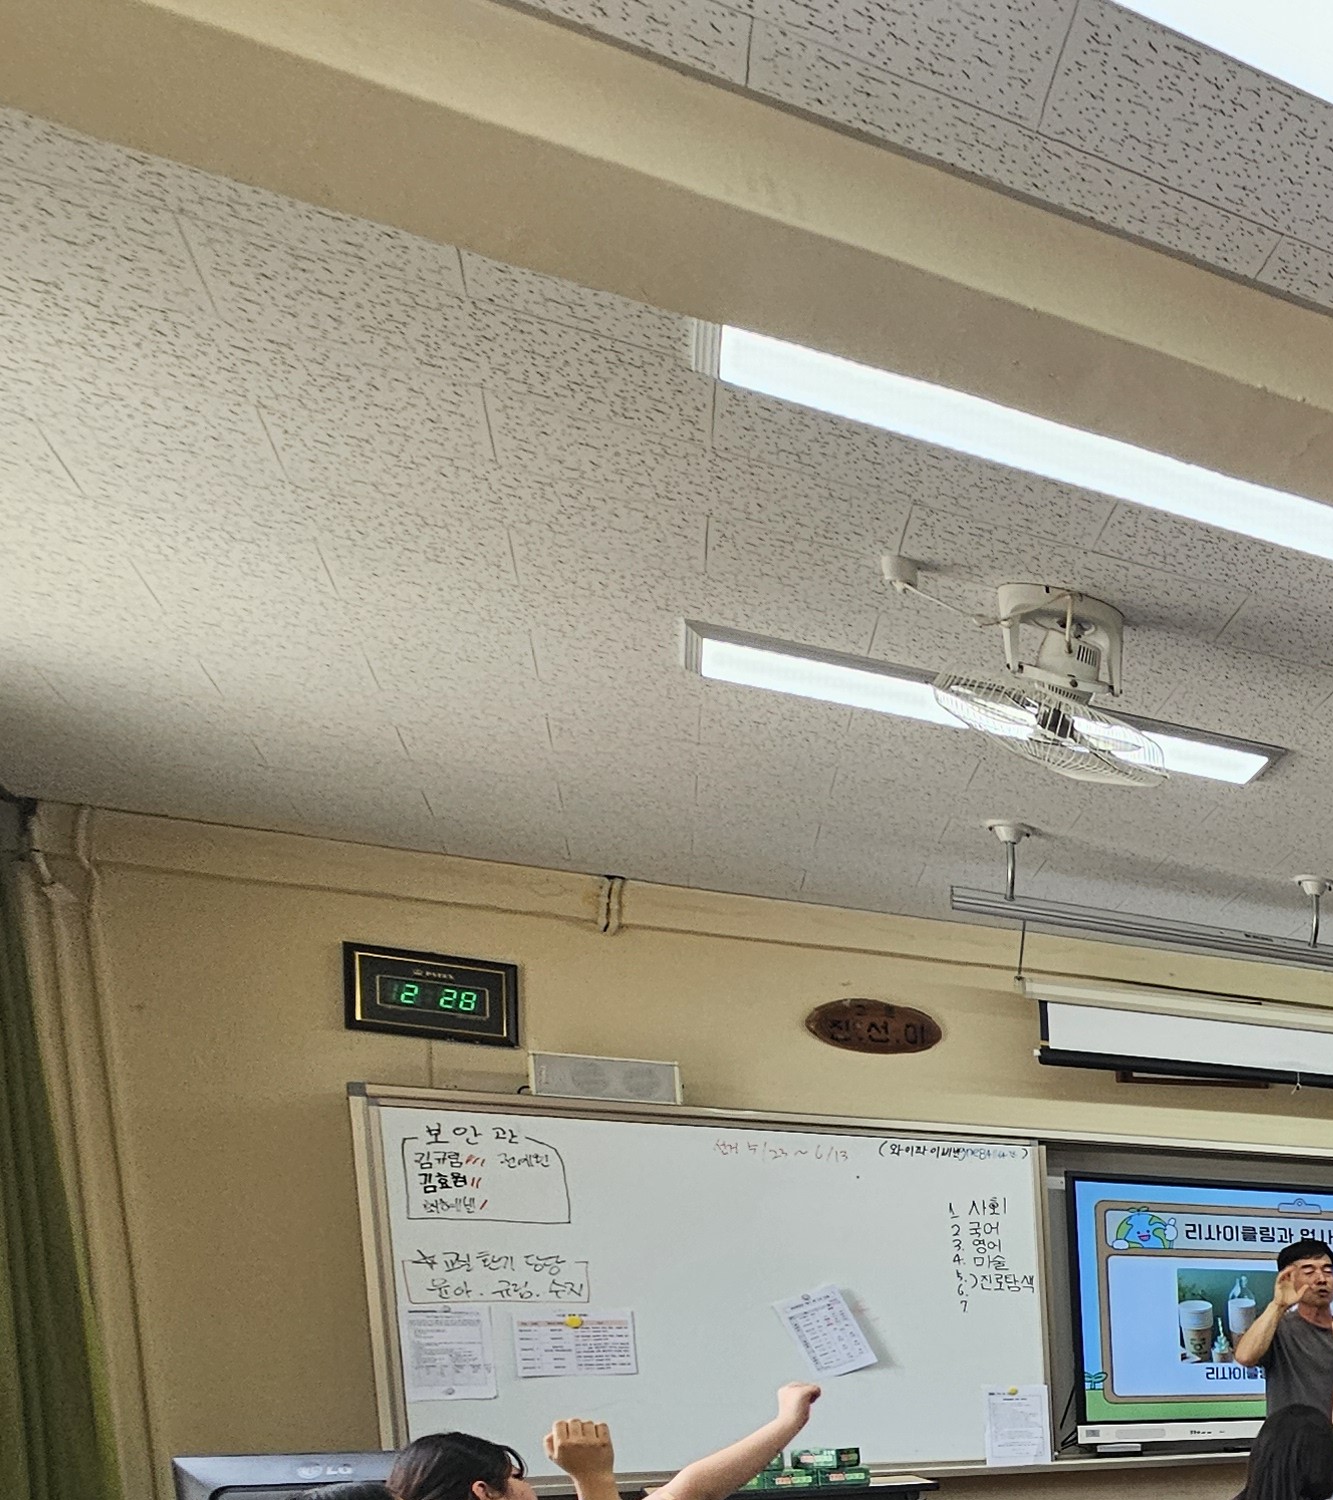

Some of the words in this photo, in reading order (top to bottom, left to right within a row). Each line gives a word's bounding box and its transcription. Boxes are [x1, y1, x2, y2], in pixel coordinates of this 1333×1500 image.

[400, 984, 418, 1004] 2
[439, 988, 477, 1011] 28
[969, 1197, 1007, 1217] 사회
[969, 1222, 1000, 1236] 국어
[1185, 1224, 1294, 1244] 리사이클링과
[973, 1239, 1002, 1253] 영어
[974, 1255, 1009, 1271] 미술
